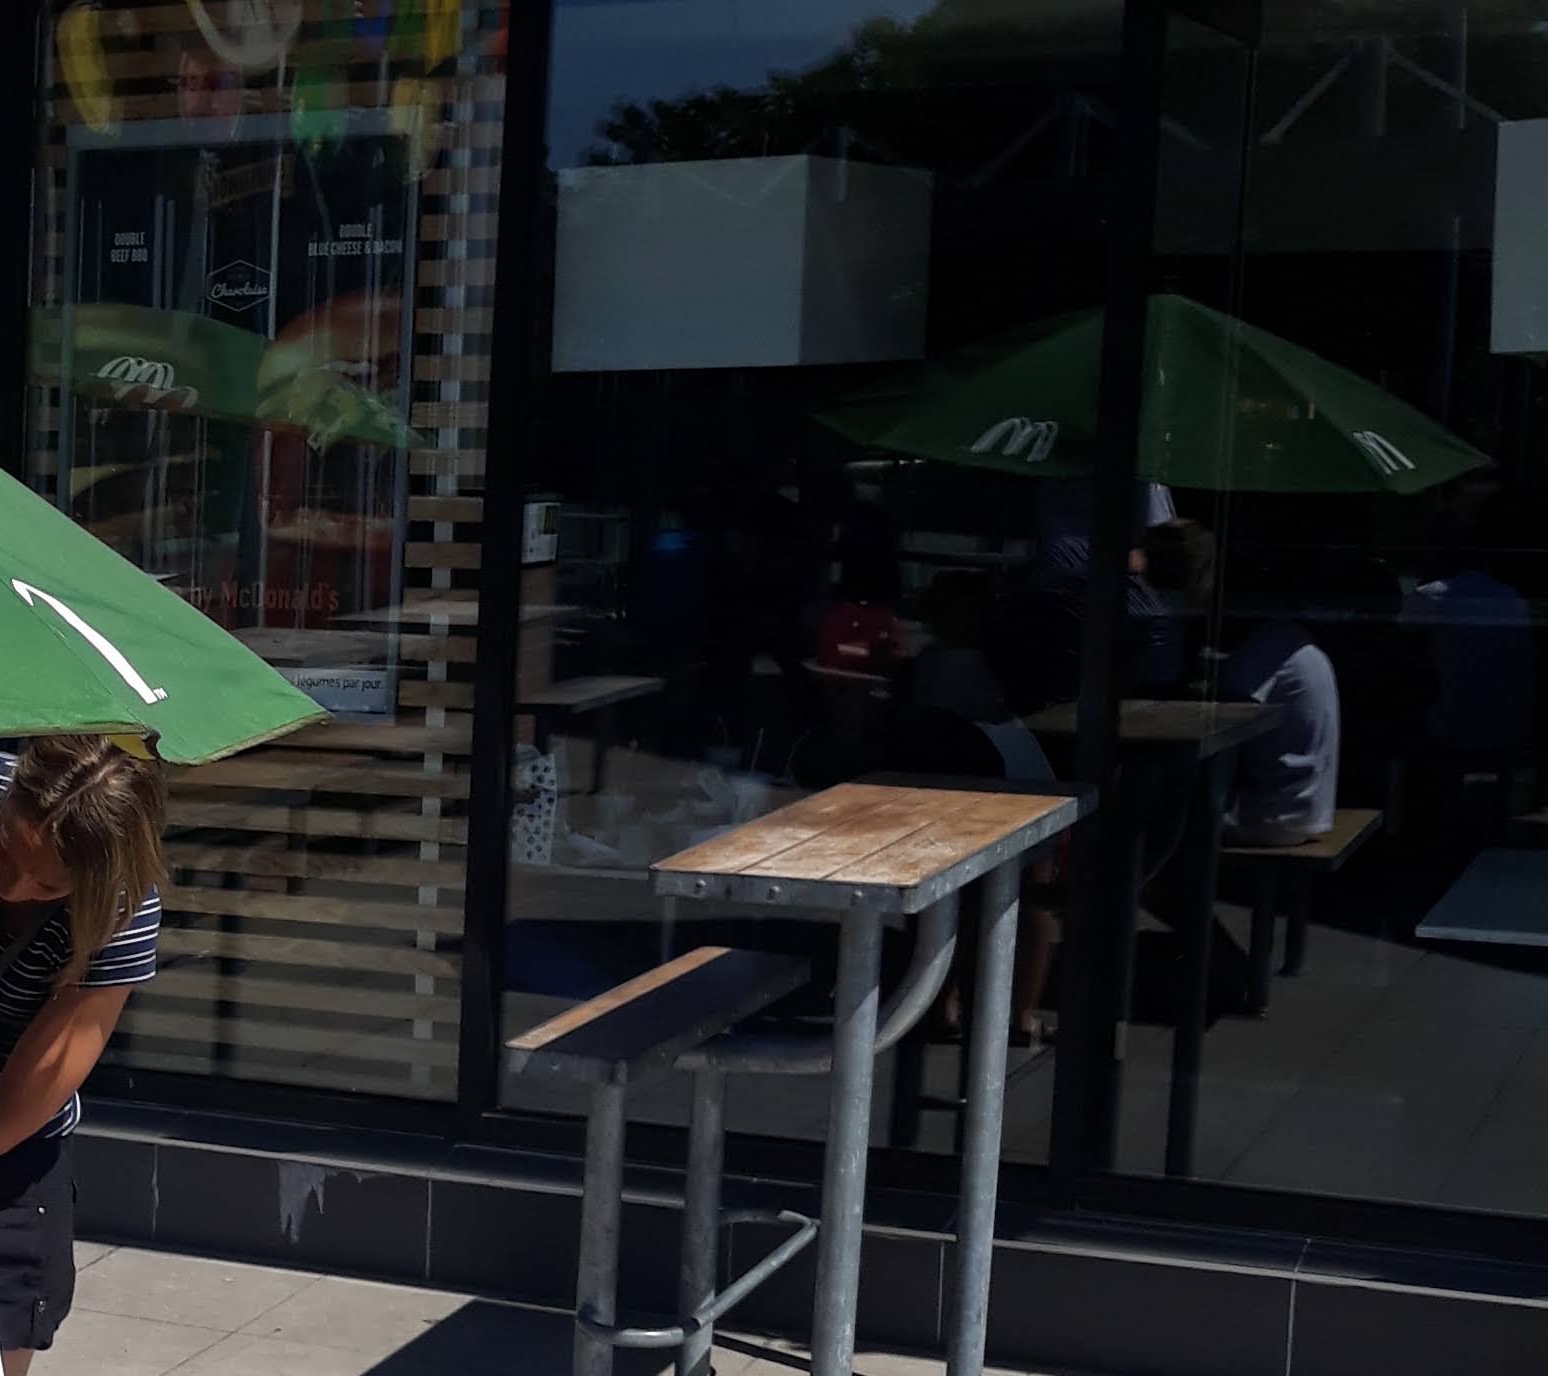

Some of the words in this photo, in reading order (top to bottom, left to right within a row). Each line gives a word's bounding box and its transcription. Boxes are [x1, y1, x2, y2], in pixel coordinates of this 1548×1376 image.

[330, 241, 363, 255] CHEESE
[220, 579, 340, 611] McDonald's
[342, 678, 360, 692] par
